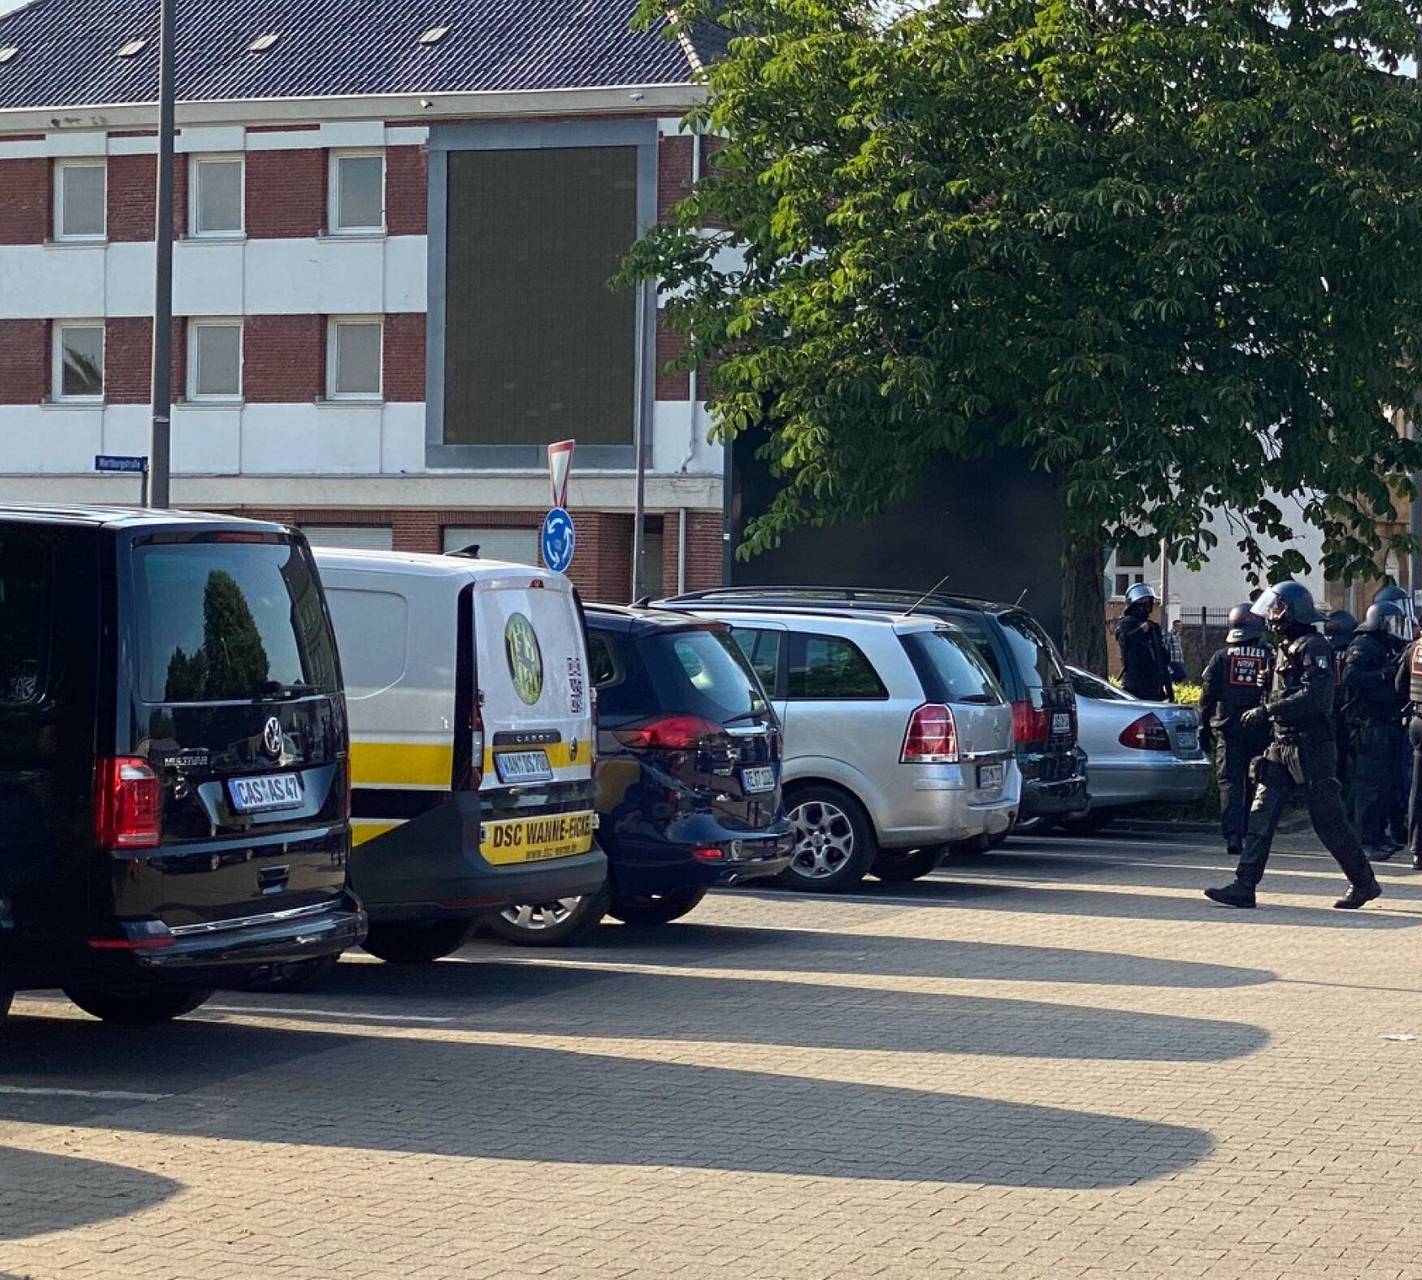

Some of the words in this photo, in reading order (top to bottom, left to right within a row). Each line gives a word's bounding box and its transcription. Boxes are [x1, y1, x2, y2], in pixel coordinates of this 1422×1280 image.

[1227, 646, 1265, 657] POLIZEI
[237, 780, 263, 805] CAS
[268, 779, 285, 801] AS
[287, 777, 299, 800] 47
[493, 824, 522, 848] DSC
